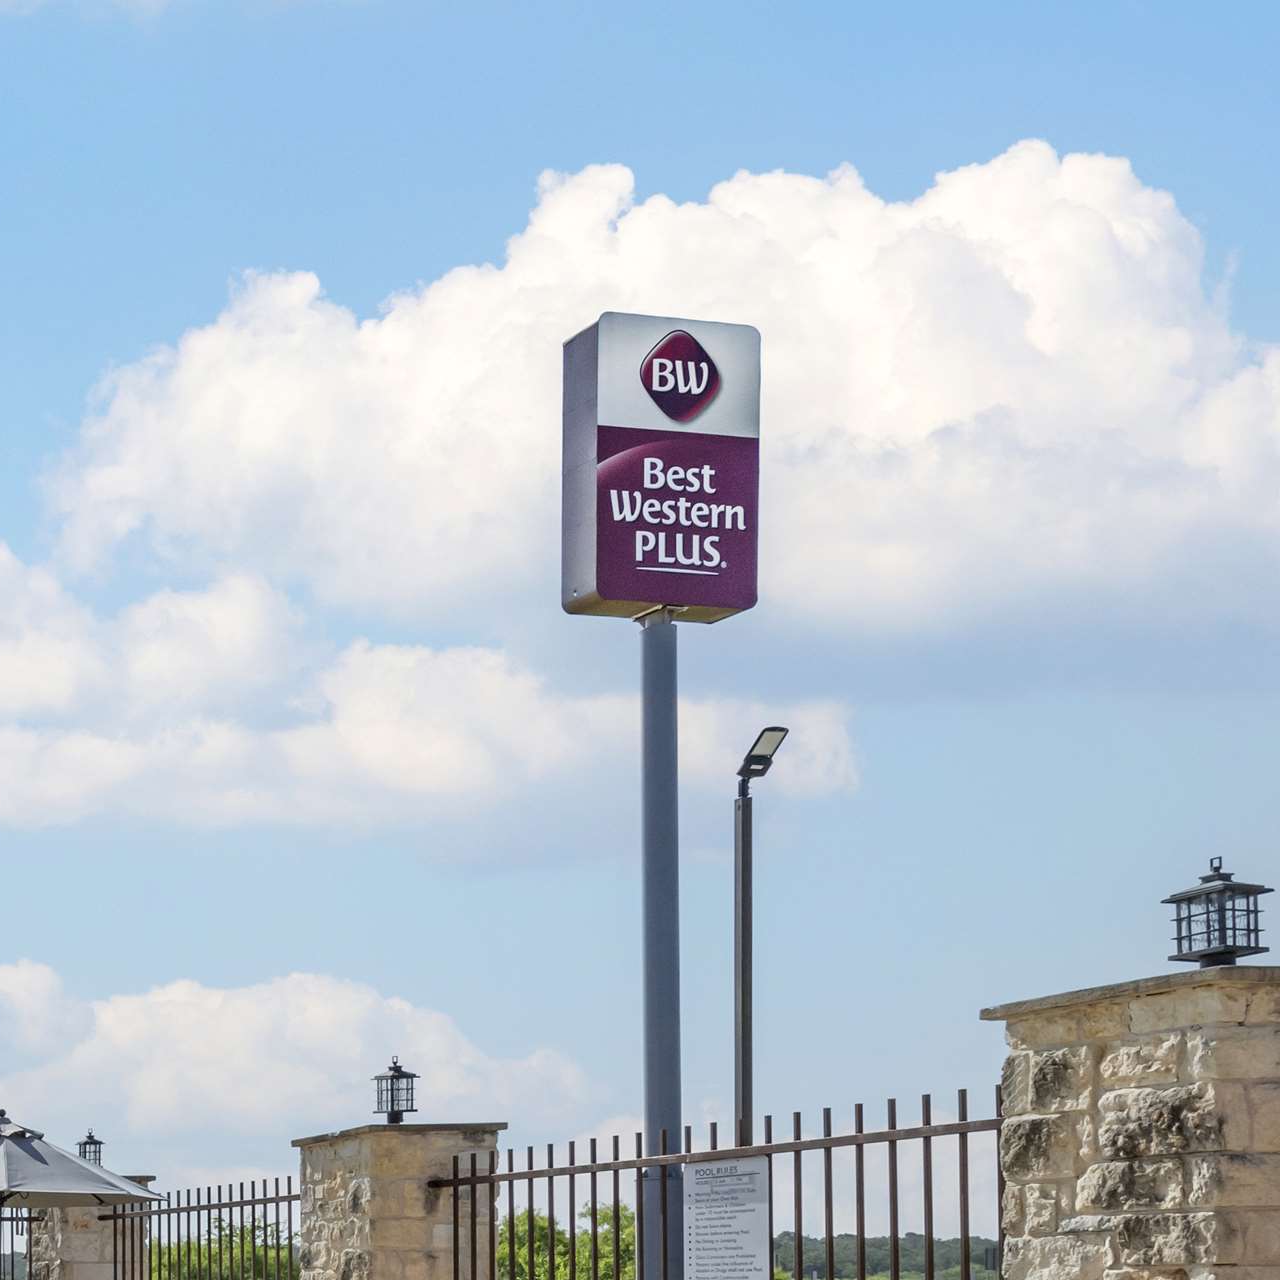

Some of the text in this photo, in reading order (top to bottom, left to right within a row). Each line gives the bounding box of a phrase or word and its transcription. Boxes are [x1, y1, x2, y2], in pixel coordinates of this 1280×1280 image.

[652, 358, 709, 395] BW
[643, 457, 717, 494] Best
[609, 489, 747, 530] Western
[695, 1167, 715, 1177] POOL
